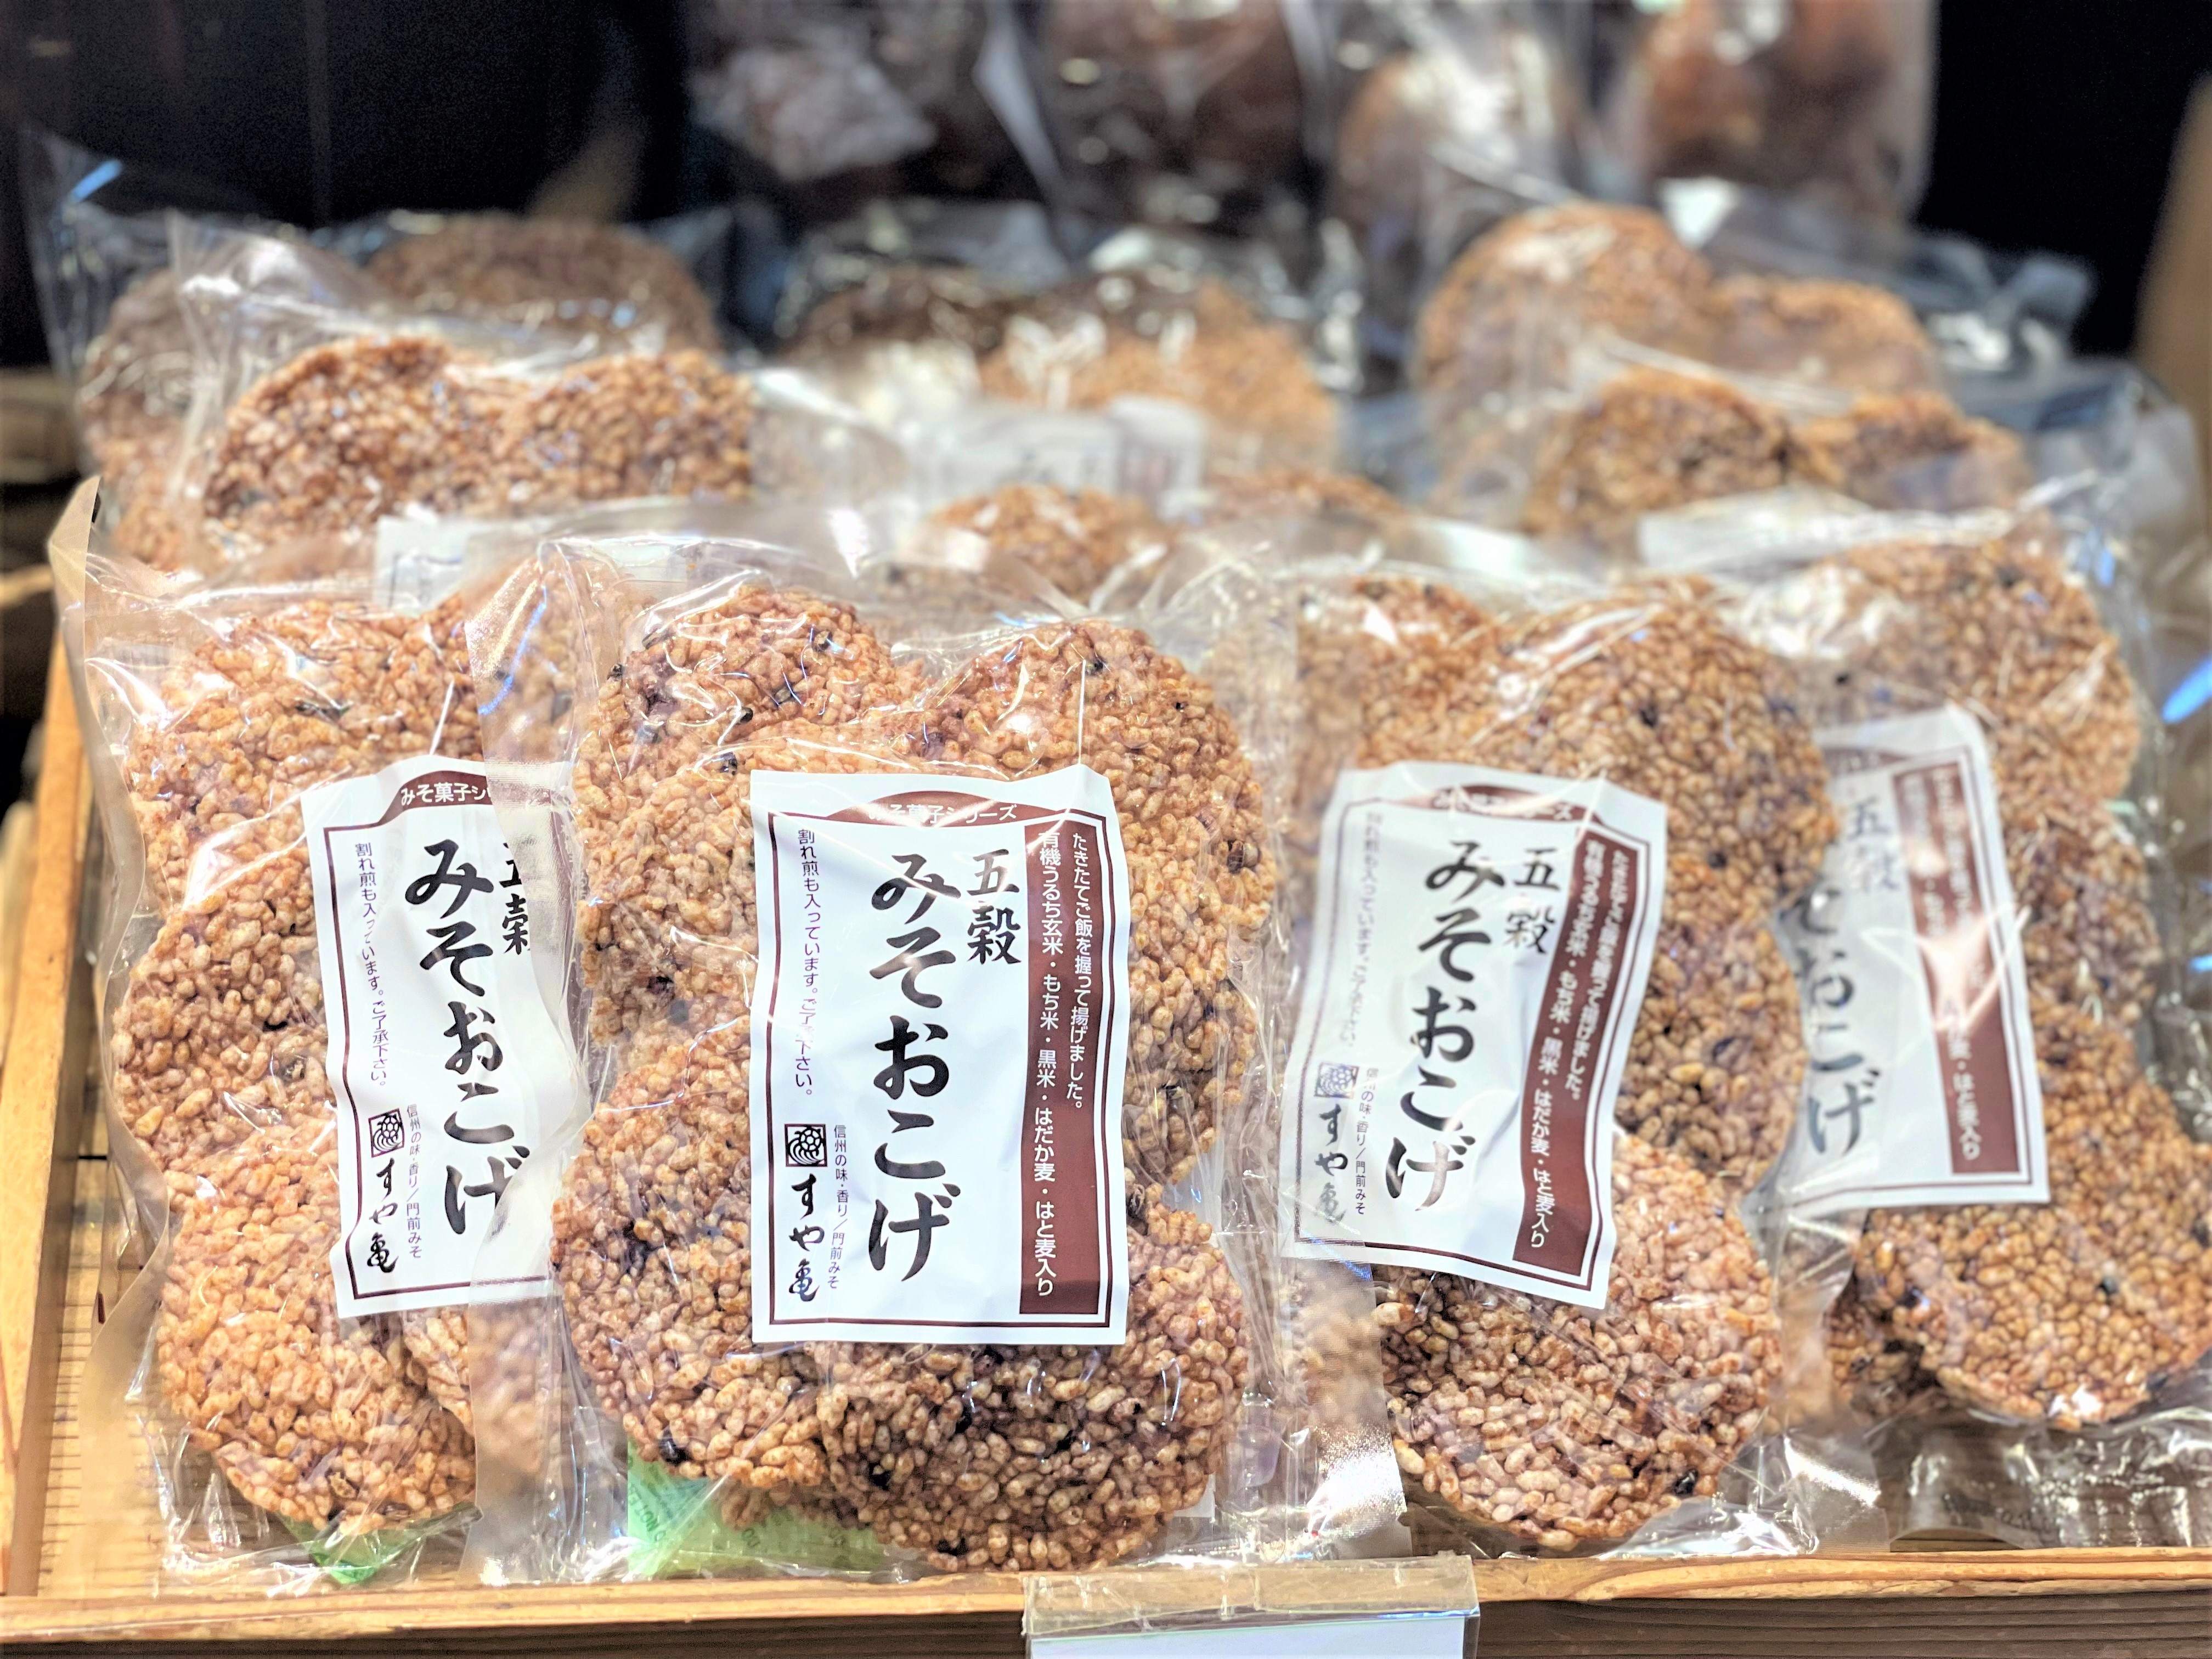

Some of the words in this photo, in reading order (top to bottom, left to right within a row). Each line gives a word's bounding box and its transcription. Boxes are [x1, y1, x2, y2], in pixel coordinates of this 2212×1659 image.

[405, 838, 530, 1235] みそおこげ
[795, 828, 821, 1096] 割れ煎も入っています。ご了下さい。
[966, 848, 1022, 965] 五穀
[1066, 832, 1093, 1109] たきたてご飯を握って揚げました。
[1385, 840, 1505, 1211] みそおこげ
[868, 853, 961, 1282] みそおこげ
[1034, 831, 1064, 1297] 有機うるち玄米・もち米・黒米・はだか麦・はと麦入り
[788, 1172, 826, 1302] すや亀
[827, 1124, 850, 1289] 信州の味・香り／門前みそ
